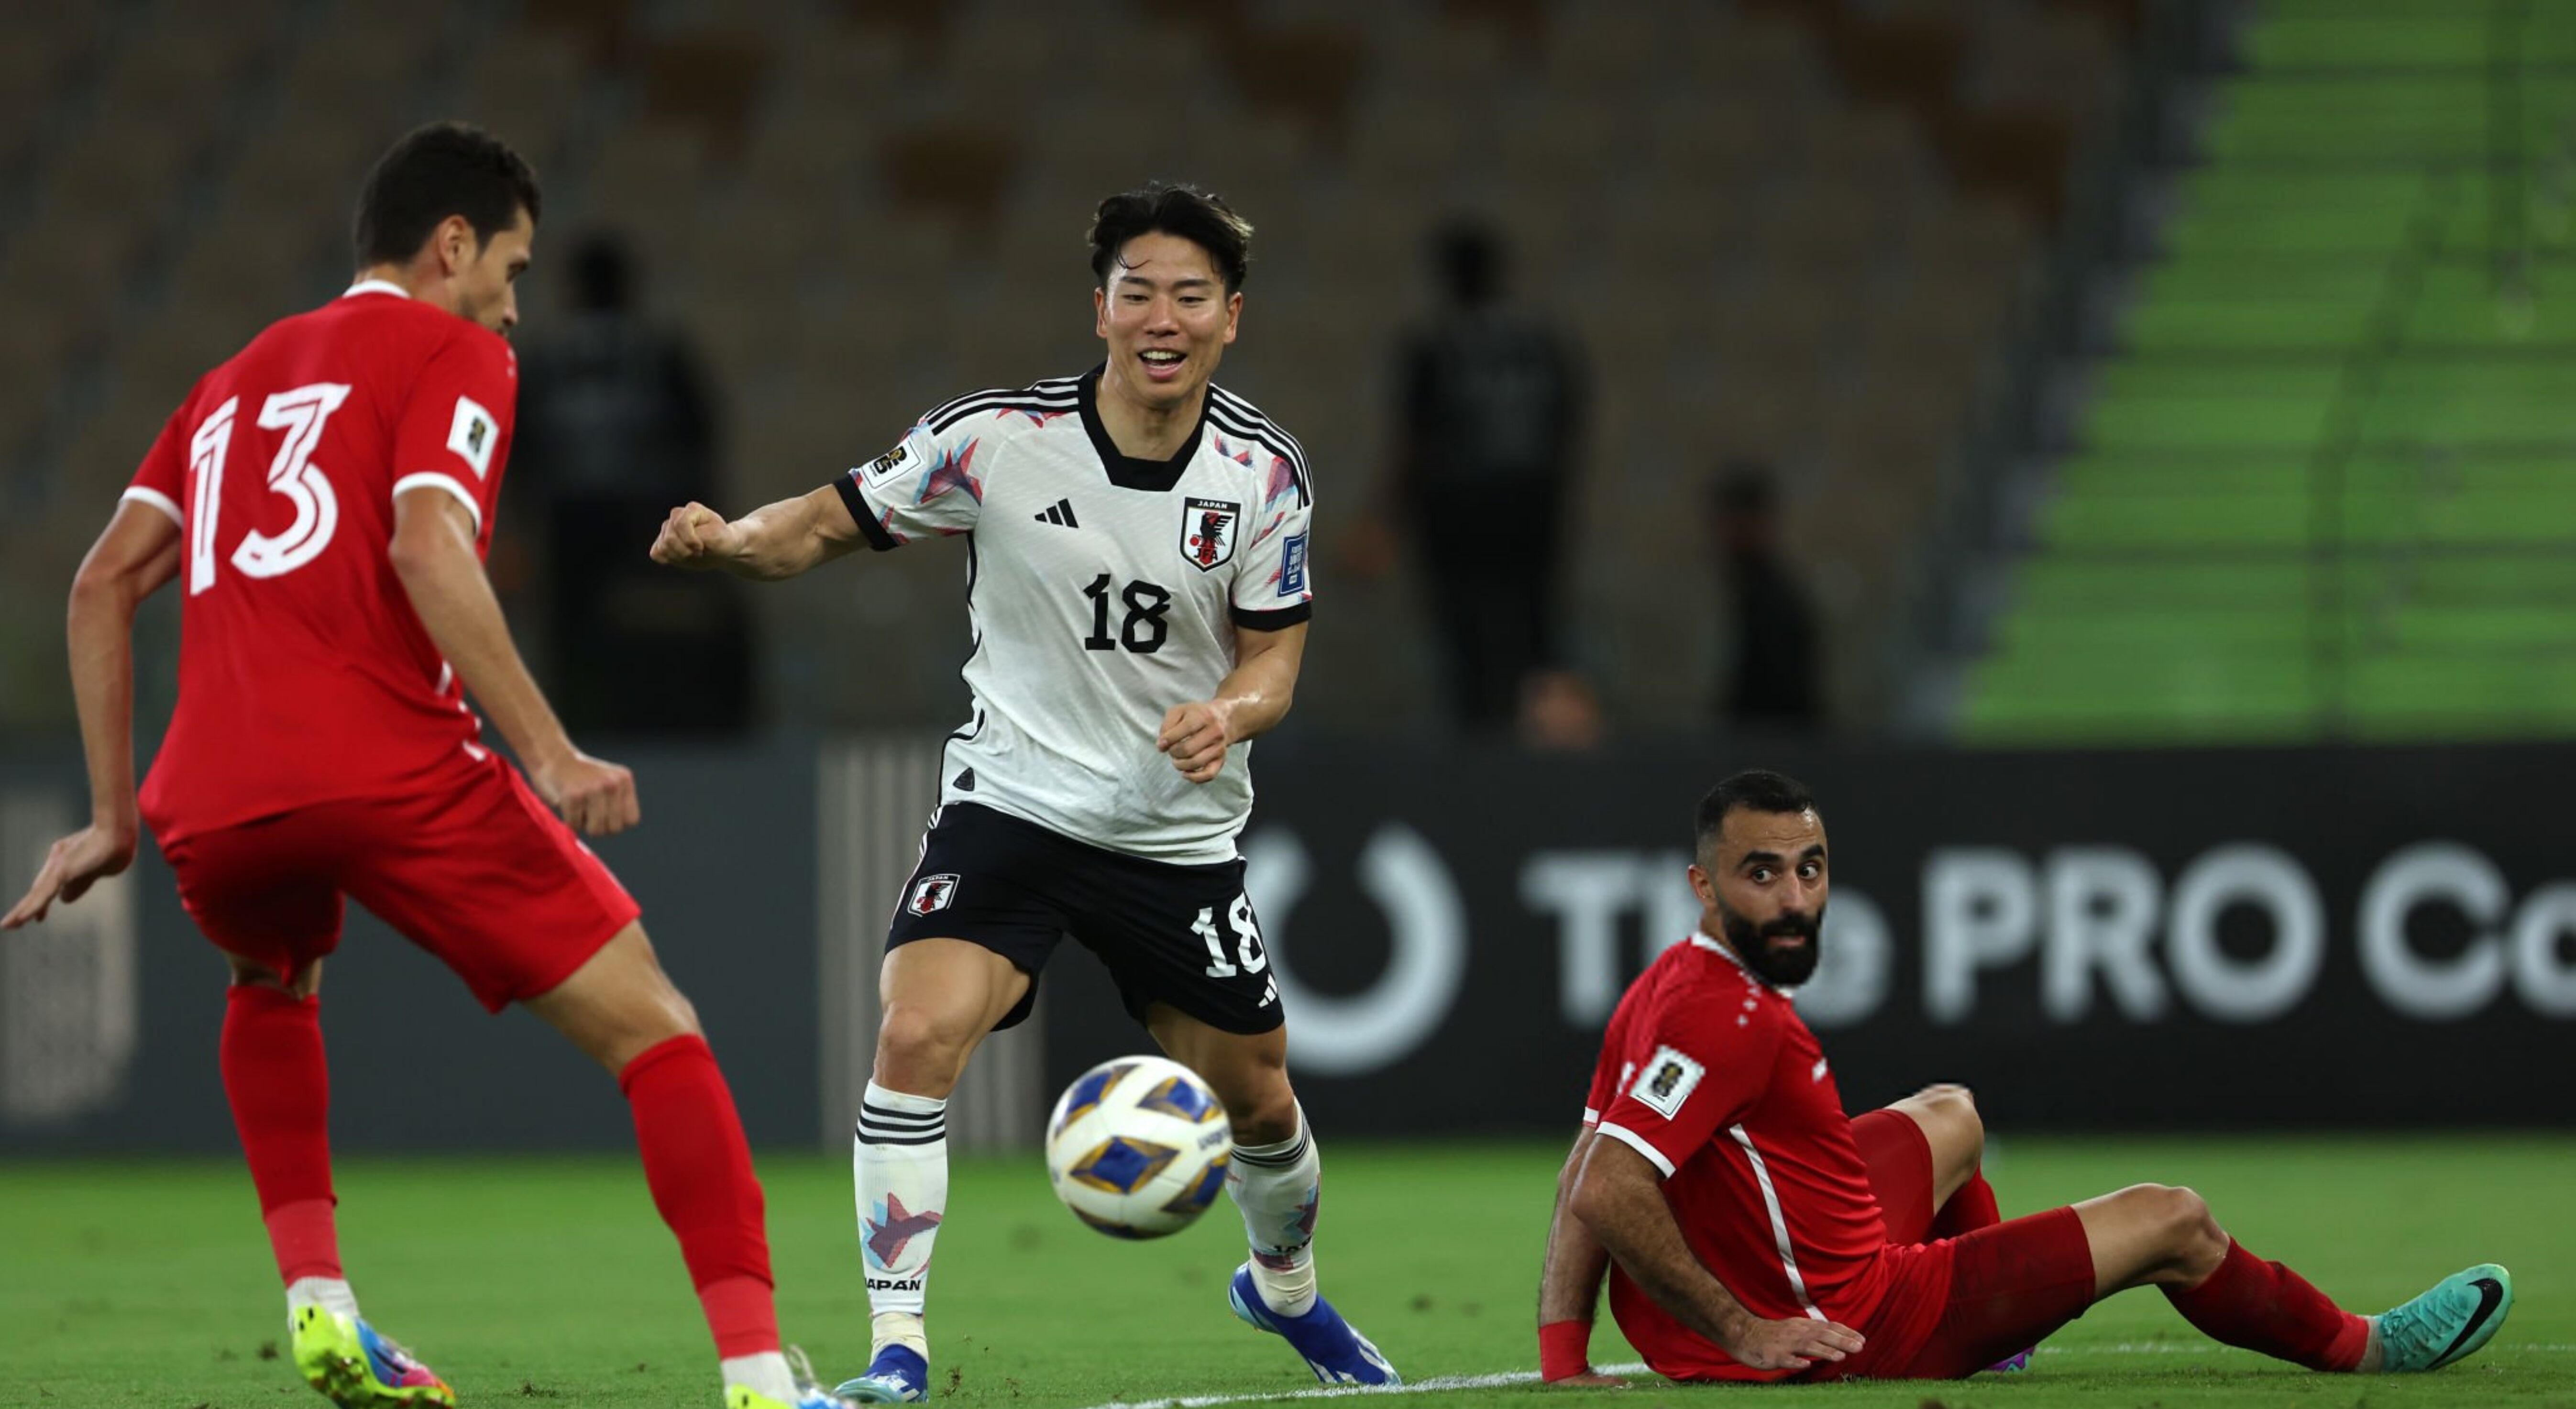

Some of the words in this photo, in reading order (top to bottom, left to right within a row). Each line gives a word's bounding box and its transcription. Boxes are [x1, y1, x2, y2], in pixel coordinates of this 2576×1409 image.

[190, 383, 352, 596] 13
[1197, 500, 1228, 509] JAPAN
[1083, 573, 1171, 653] 18
[1190, 891, 1266, 977] 18
[1521, 849, 1894, 1024] Te
[1922, 844, 2324, 1021] PRO
[865, 1277, 921, 1291] APAN
